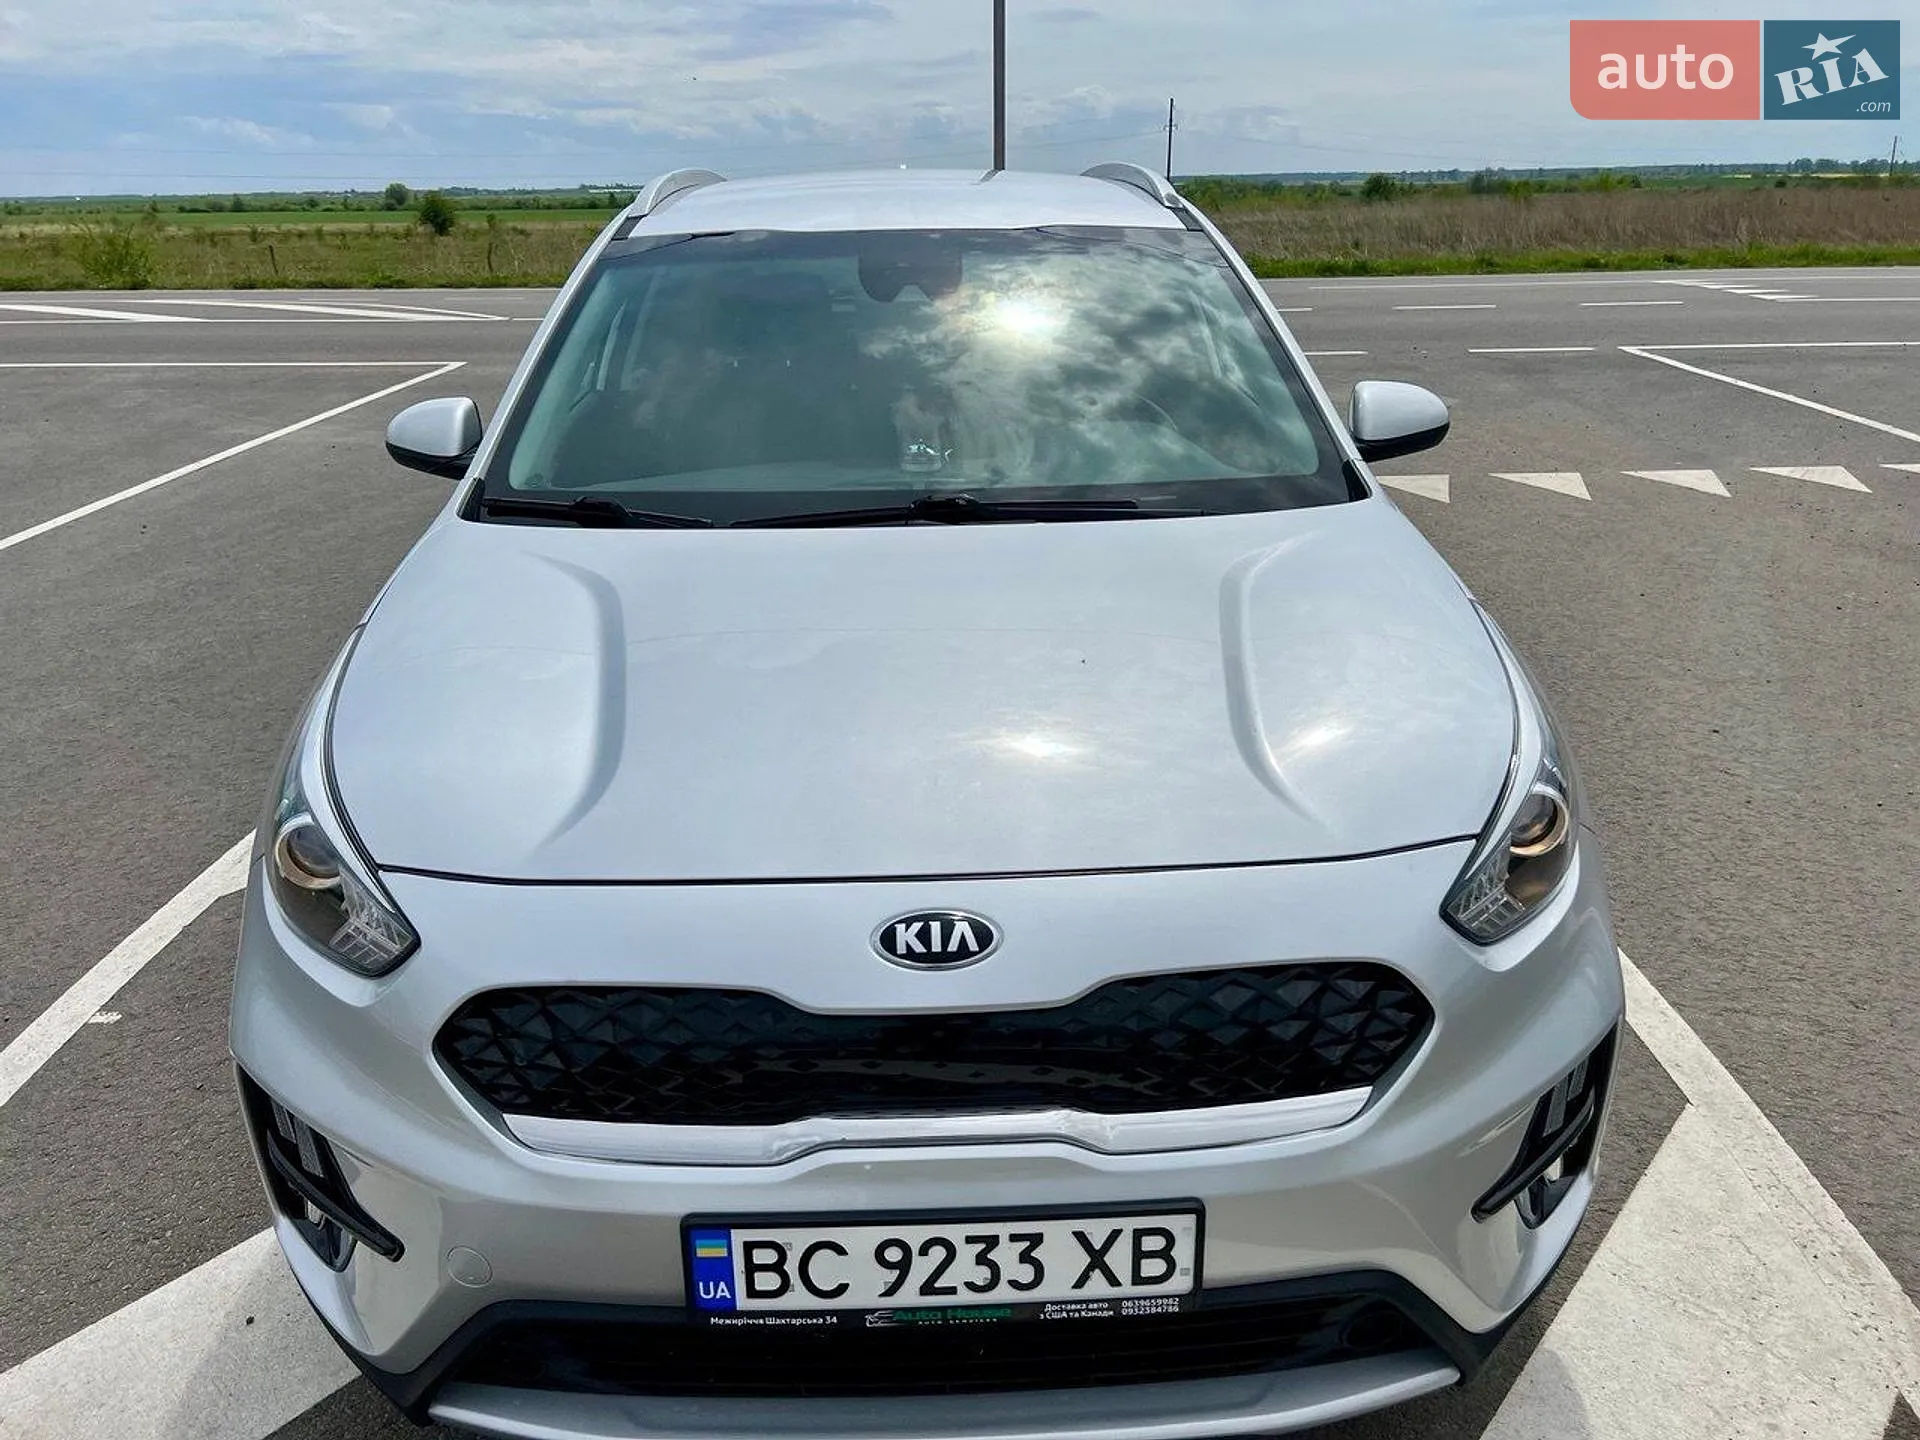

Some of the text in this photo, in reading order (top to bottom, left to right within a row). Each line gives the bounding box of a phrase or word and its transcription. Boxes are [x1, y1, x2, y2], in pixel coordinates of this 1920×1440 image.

[894, 920, 979, 954] KIA
[742, 1226, 1178, 1299] BC 9233 XB
[699, 1280, 731, 1299] UA
[825, 1316, 838, 1325] 34
[1046, 1311, 1068, 1320] США
